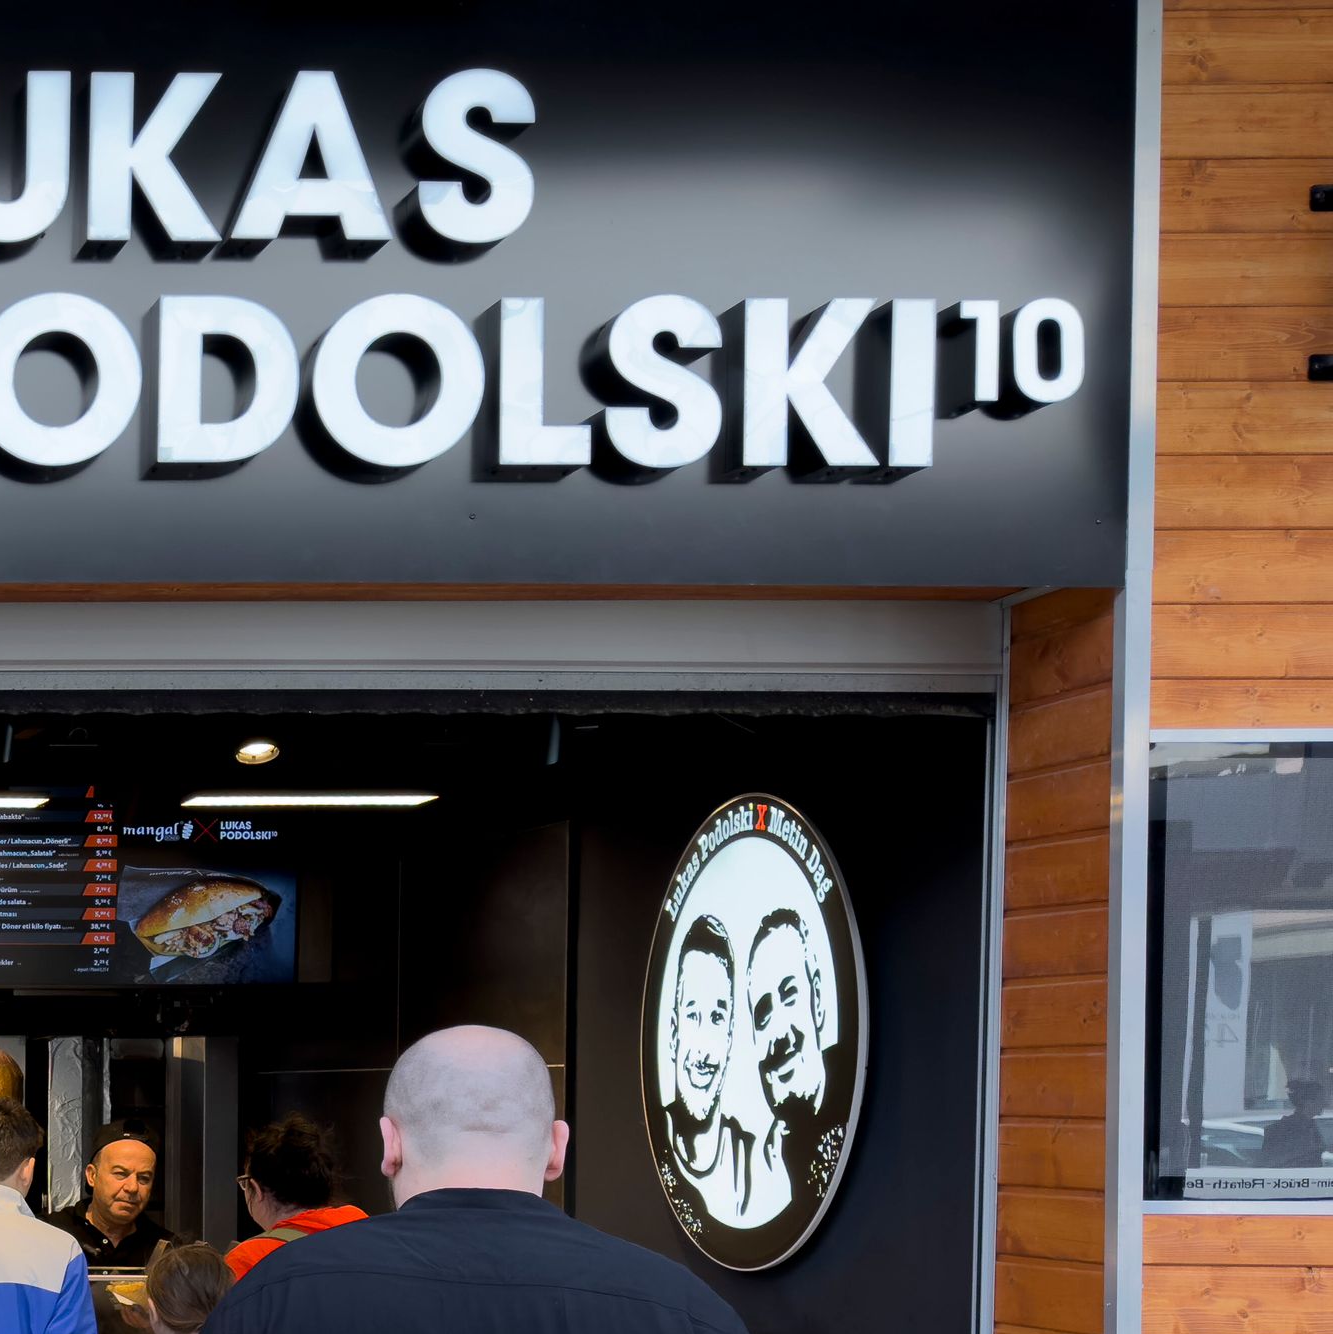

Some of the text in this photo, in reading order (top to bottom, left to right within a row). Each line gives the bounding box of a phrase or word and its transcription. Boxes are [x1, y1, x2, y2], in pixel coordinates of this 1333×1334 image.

[123, 822, 179, 842] mangal
[220, 821, 251, 830] LUKAS
[665, 850, 700, 922] Lukas
[698, 802, 754, 862] Podolski
[768, 807, 809, 860] Metin
[806, 845, 833, 904] Dag
